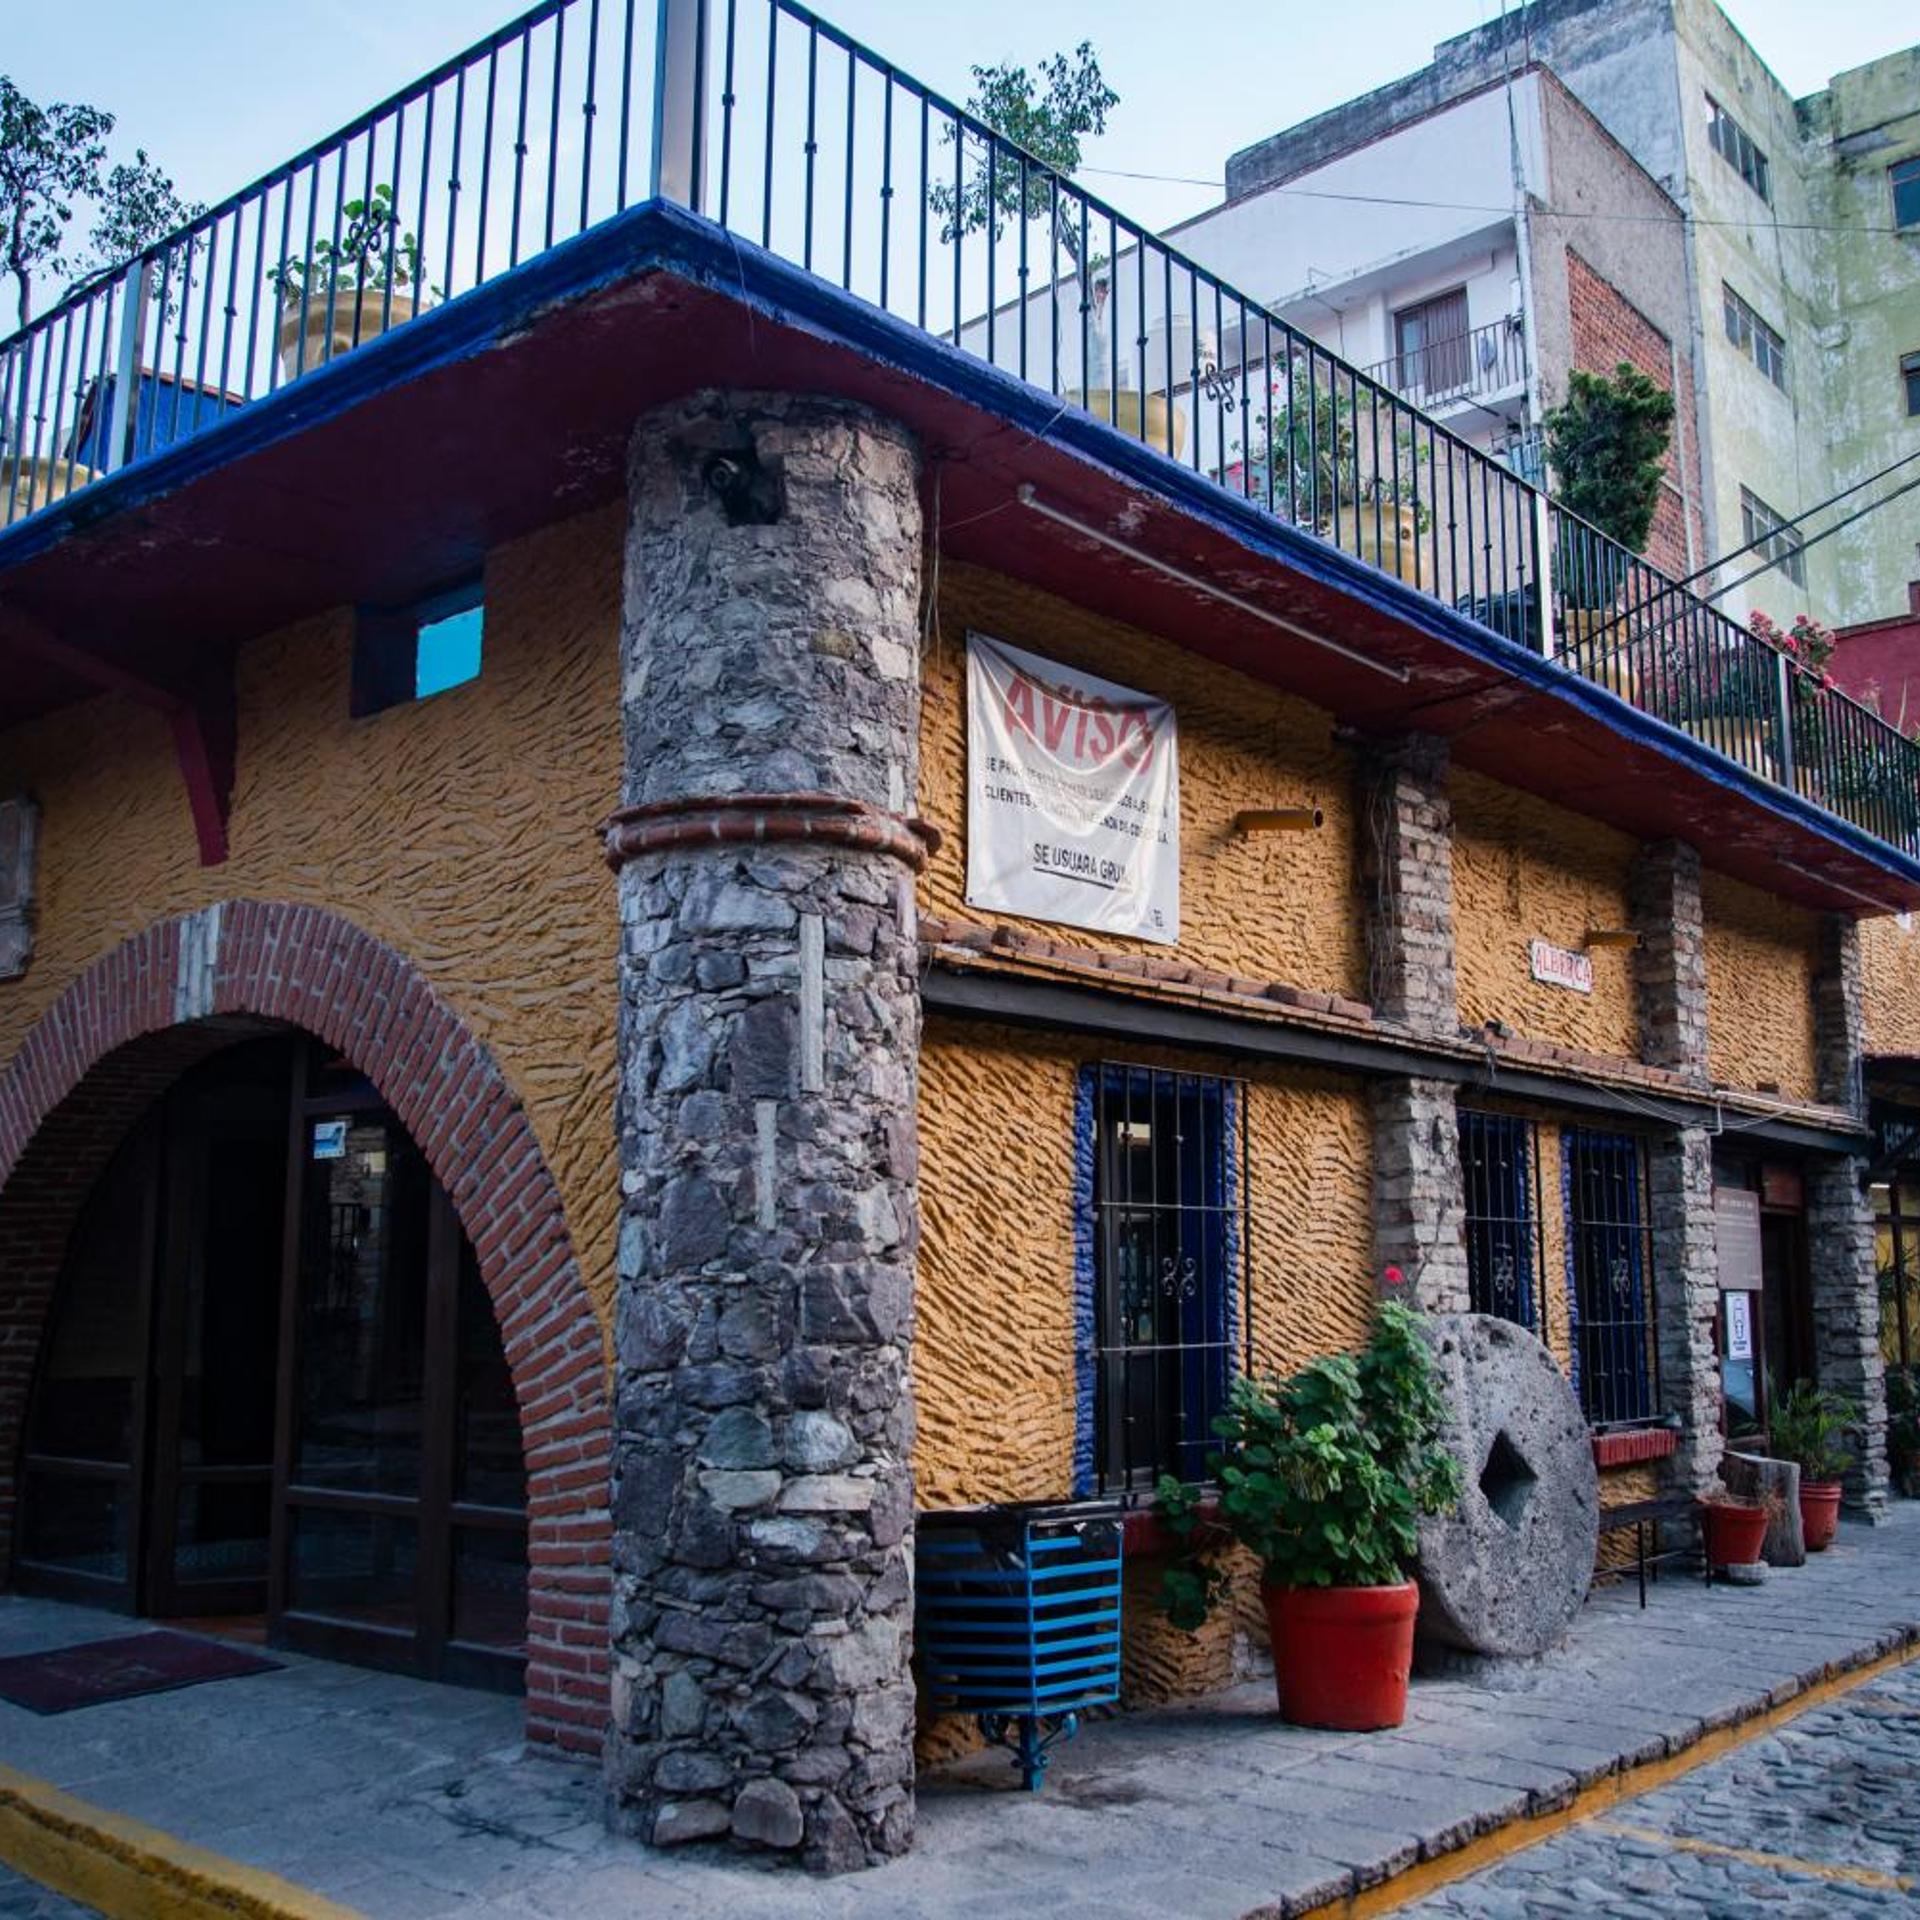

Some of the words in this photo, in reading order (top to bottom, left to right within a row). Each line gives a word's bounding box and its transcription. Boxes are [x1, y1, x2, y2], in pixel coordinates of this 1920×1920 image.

[1004, 676, 1154, 775] AVISO
[1034, 844, 1049, 865] SE
[1053, 849, 1097, 876] USUARA
